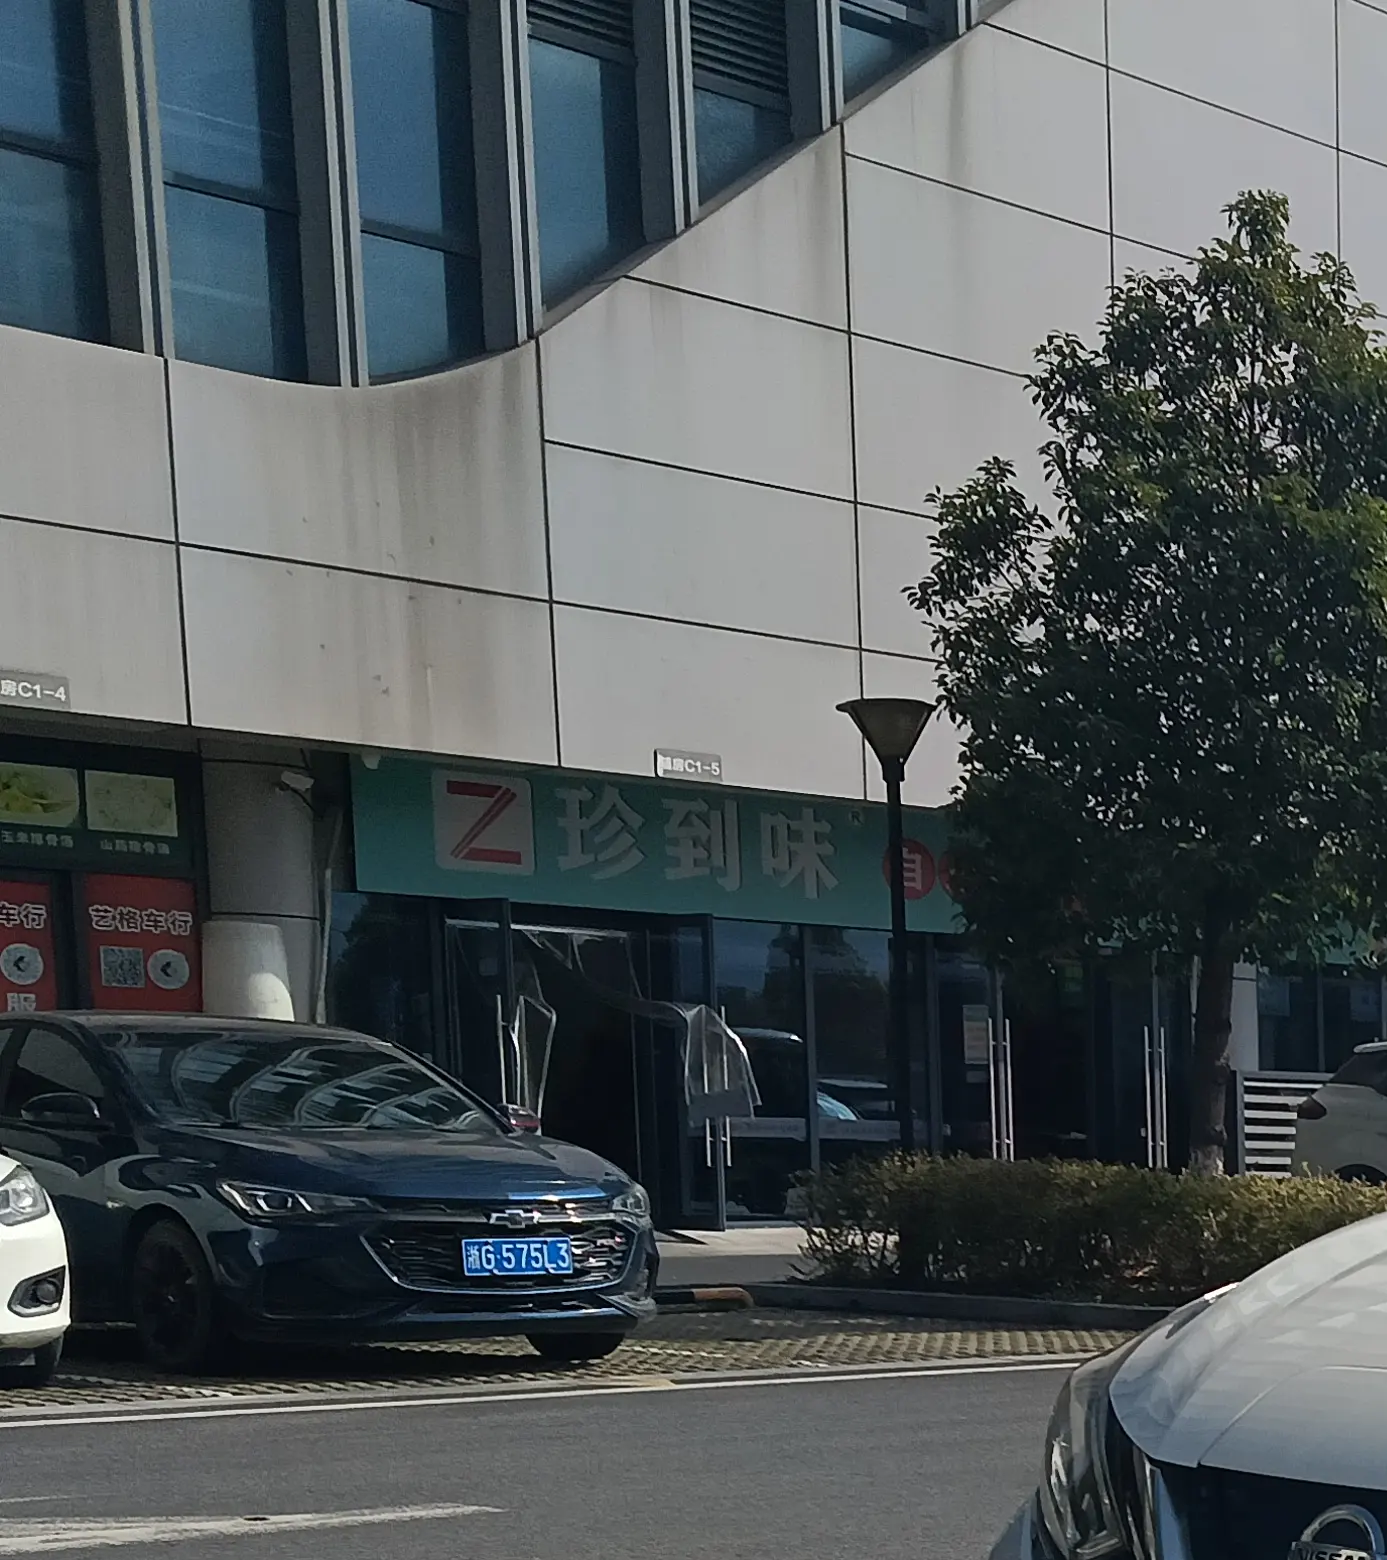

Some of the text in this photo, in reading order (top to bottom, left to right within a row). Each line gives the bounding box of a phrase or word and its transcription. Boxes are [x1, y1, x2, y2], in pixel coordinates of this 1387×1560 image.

[554, 783, 839, 899] 珍到味
[88, 904, 193, 936] 艺格车行
